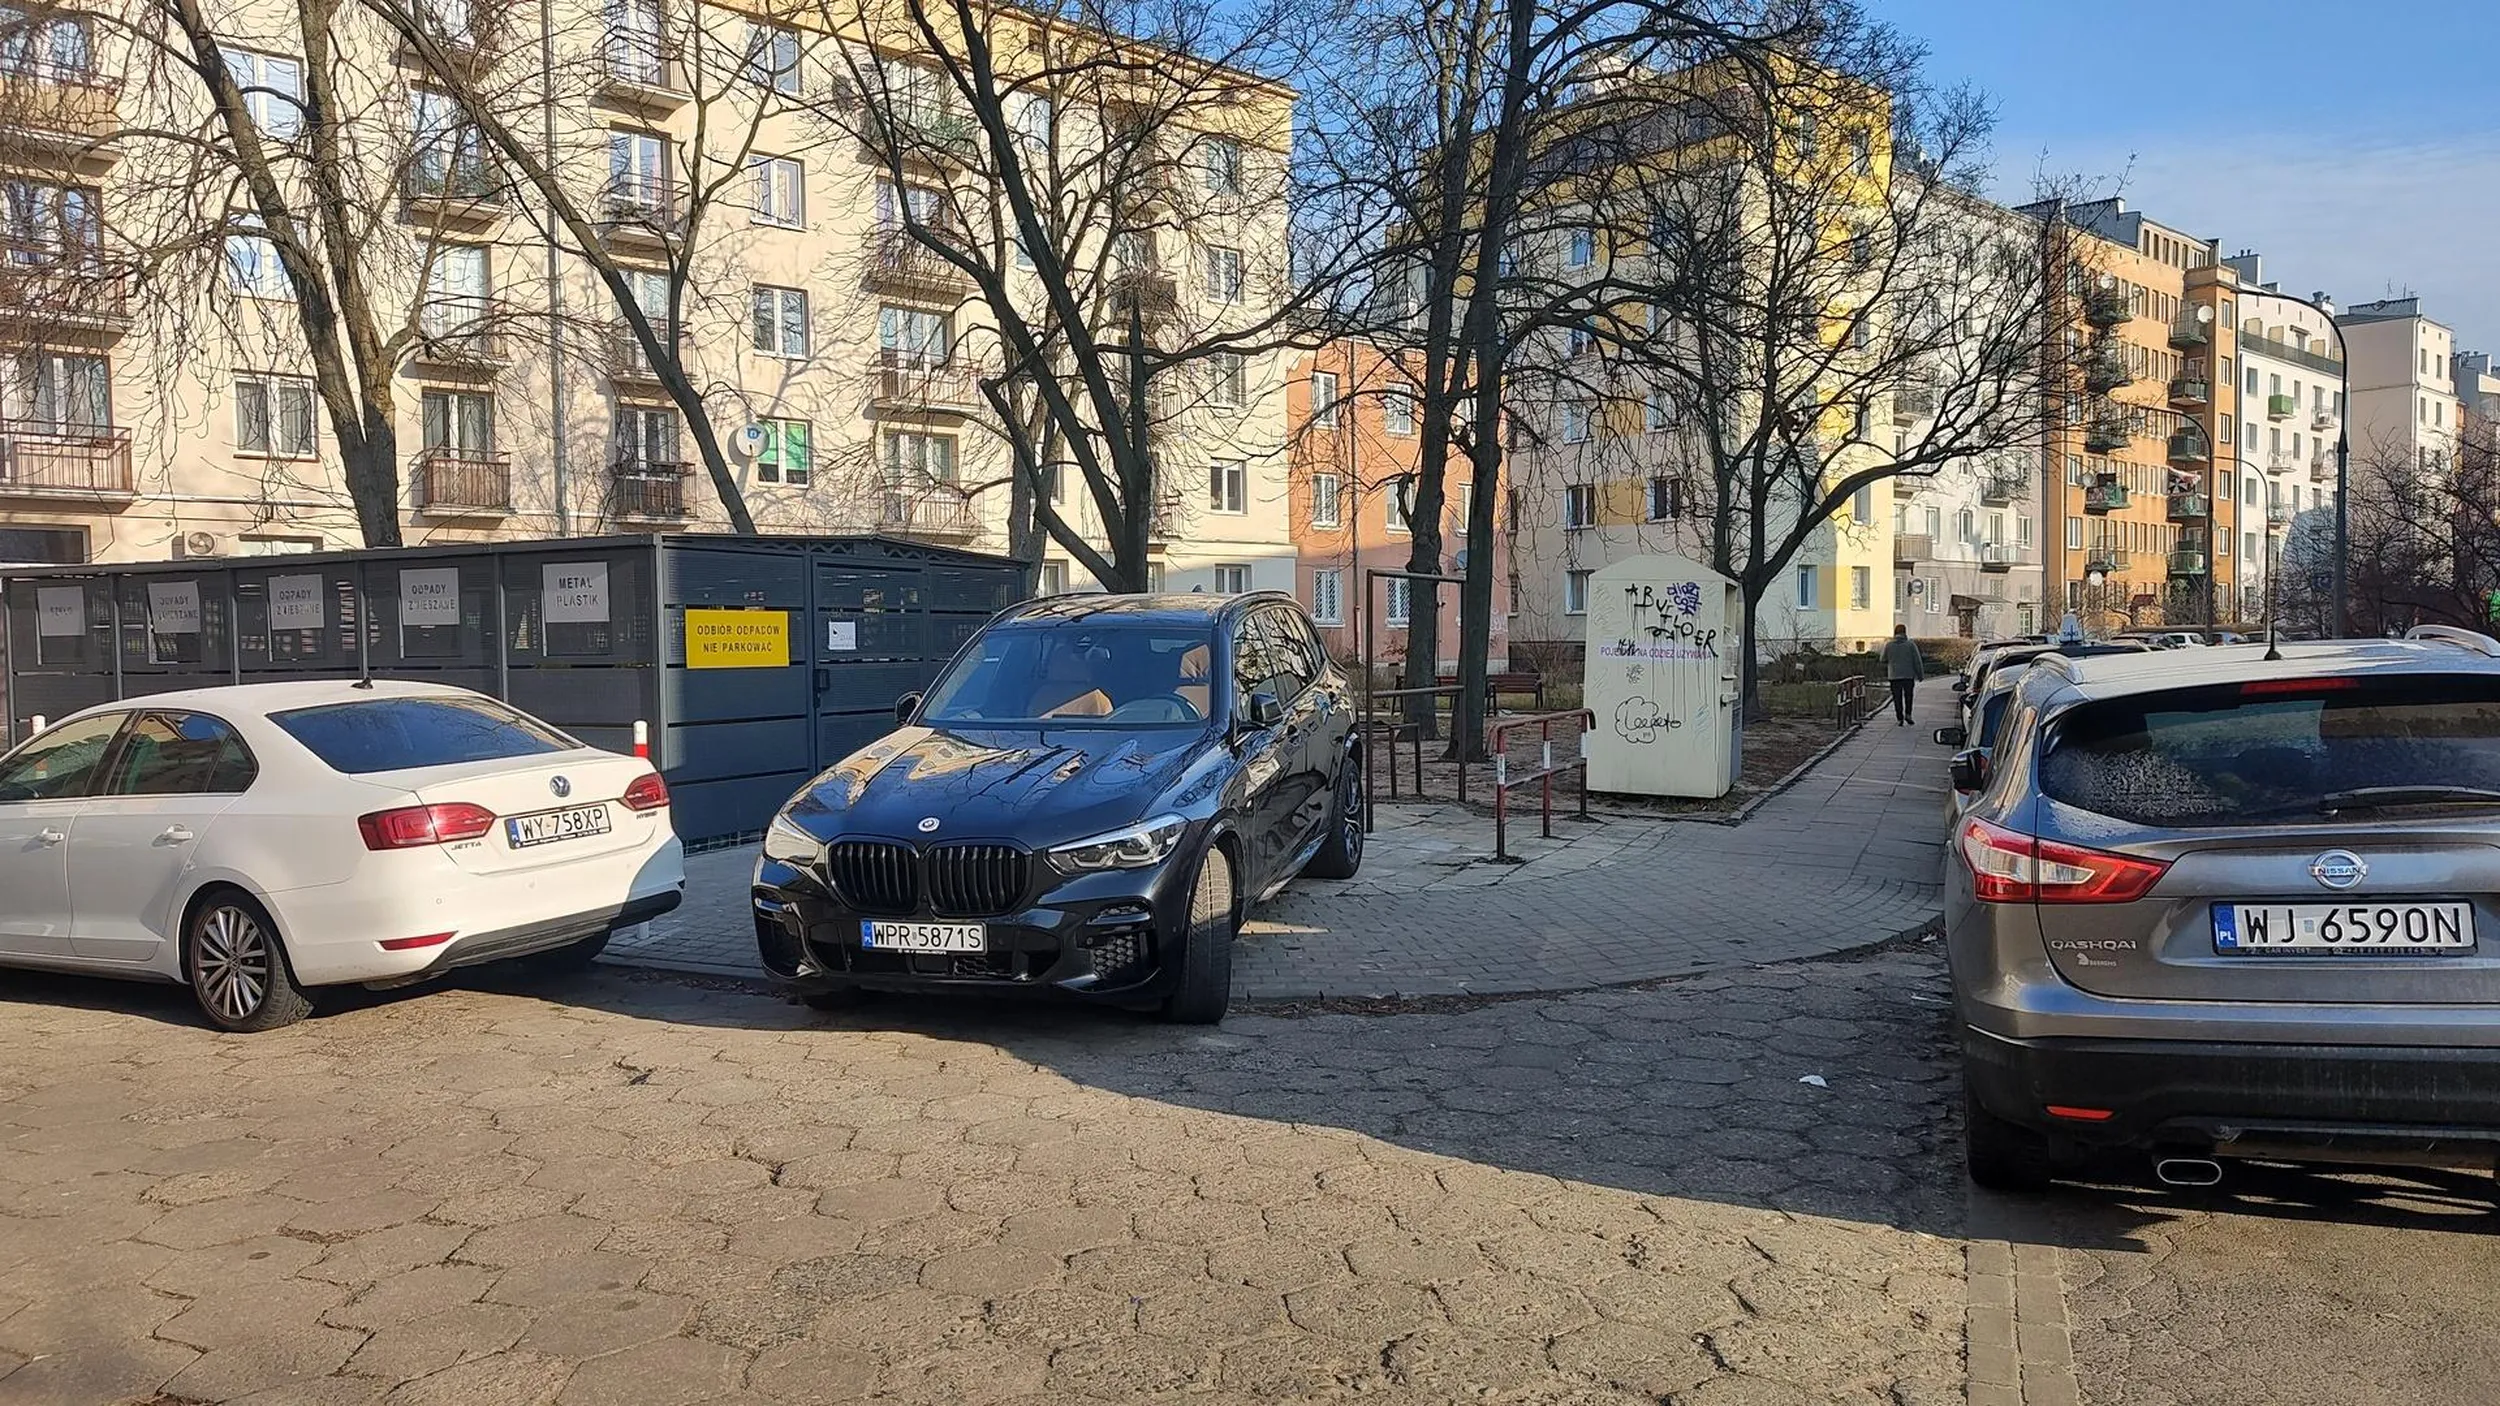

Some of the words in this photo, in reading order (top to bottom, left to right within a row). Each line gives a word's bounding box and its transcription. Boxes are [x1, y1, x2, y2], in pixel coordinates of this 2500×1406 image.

[559, 576, 593, 589] METAL
[412, 584, 446, 594] ODPADY
[556, 594, 599, 607] PLASTIK
[703, 642, 718, 653] NIE
[521, 817, 544, 840] WY
[552, 808, 604, 834] 758XP
[451, 841, 482, 851] JETTA
[2318, 867, 2361, 876] NISSAN
[2220, 931, 2235, 940] PL
[2244, 908, 2296, 943] WJ
[2320, 907, 2462, 943] 6590N
[873, 923, 911, 947] WPR
[918, 926, 981, 949] 5871S
[2051, 940, 2137, 951] QASHQAI
